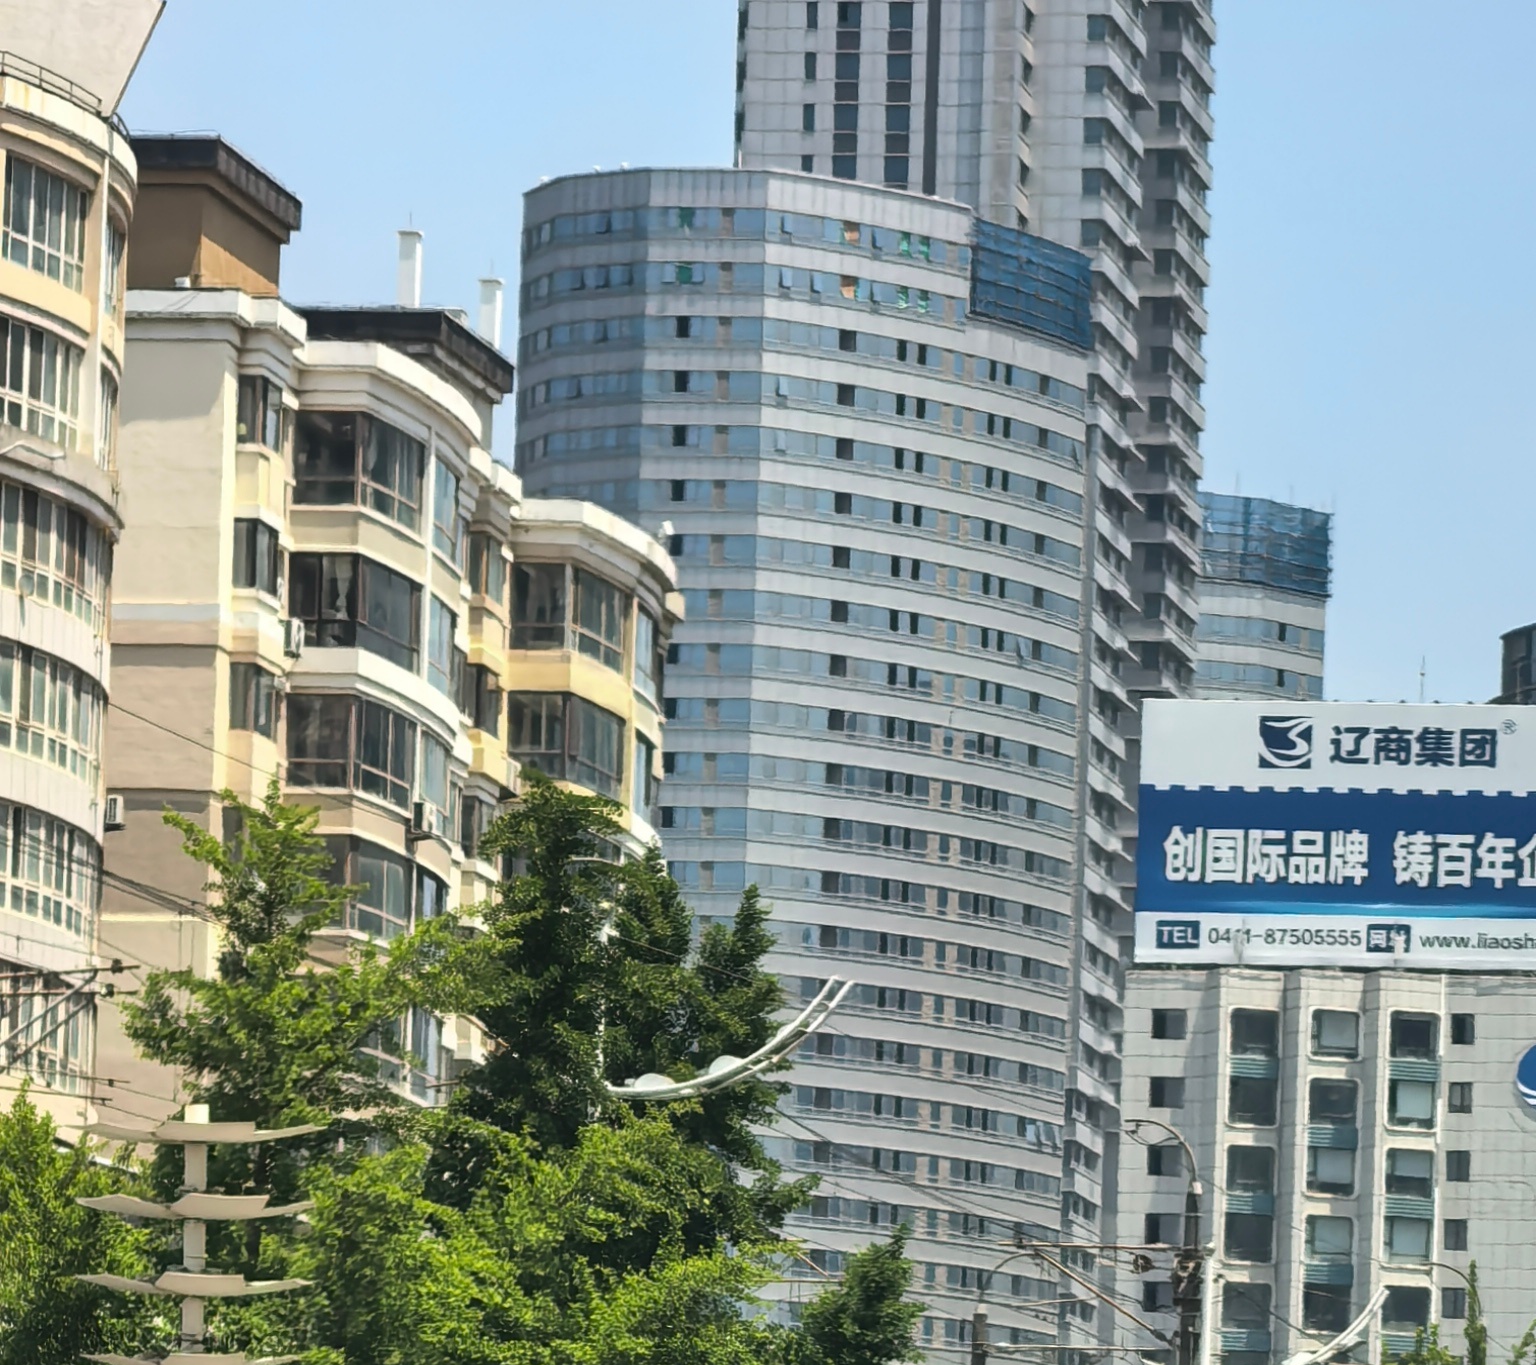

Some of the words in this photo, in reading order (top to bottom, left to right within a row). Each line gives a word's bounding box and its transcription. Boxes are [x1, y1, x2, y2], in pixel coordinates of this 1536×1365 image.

[1329, 725, 1499, 769] 辽商集团
[1162, 824, 1370, 886] 创国际品牌
[1157, 926, 1199, 944] TEL
[1207, 927, 1362, 946] 041-87505555
